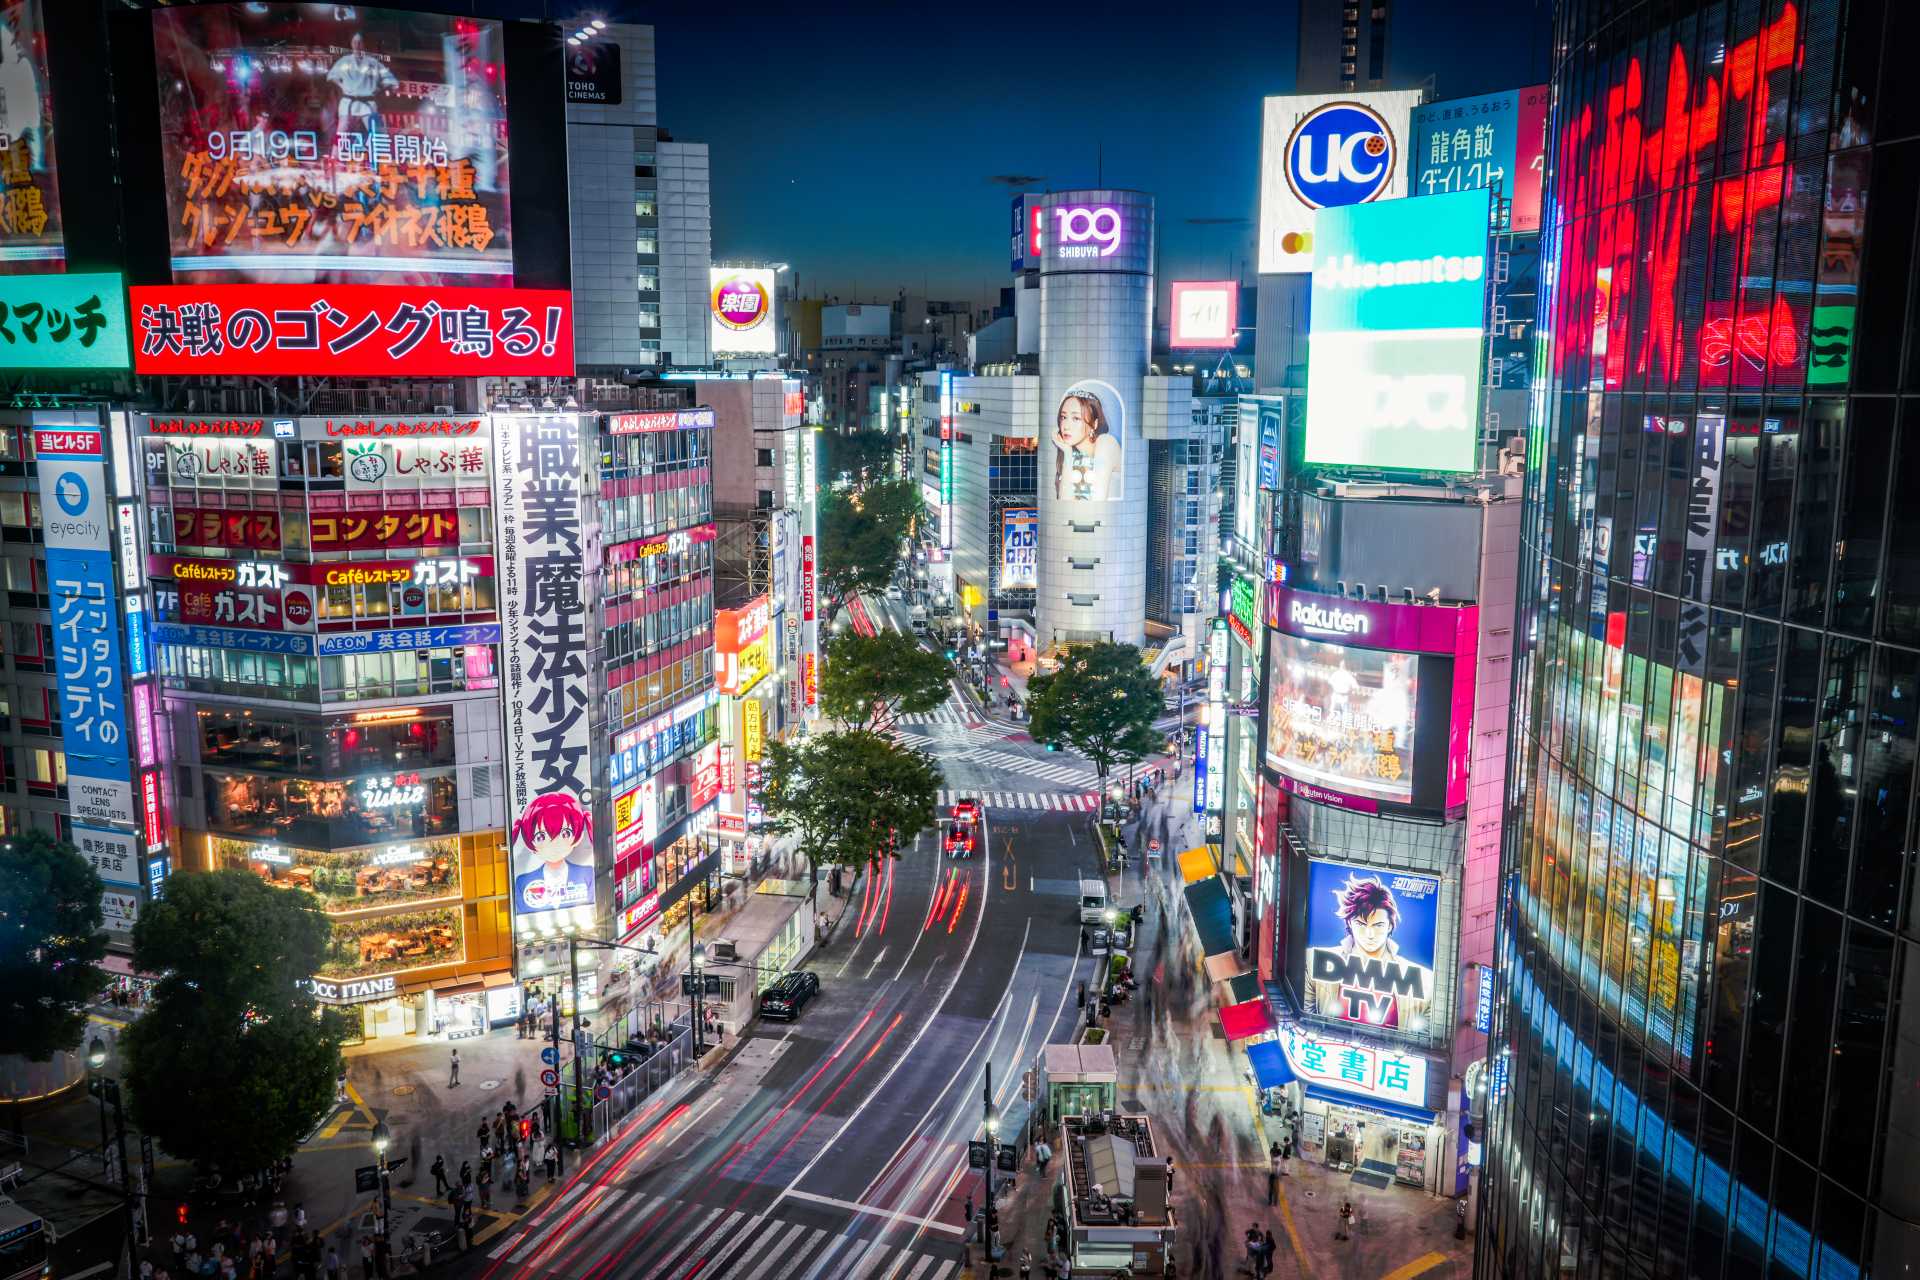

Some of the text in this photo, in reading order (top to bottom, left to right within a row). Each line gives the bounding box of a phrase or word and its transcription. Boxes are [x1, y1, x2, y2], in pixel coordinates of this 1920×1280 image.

[568, 81, 595, 91] TOHO
[568, 91, 606, 100] CINEMAS
[207, 131, 448, 167] 9月19日 配信開始
[1431, 123, 1494, 164] 龍角散
[1421, 162, 1504, 194] ダイレクト
[1056, 207, 1121, 256] 109
[1059, 246, 1099, 258] SHIBUYA
[721, 293, 761, 313] 楽園
[141, 298, 563, 359] 決戦のゴング鳴る!
[326, 420, 481, 437] しゃぶしゃぶバイキング
[41, 434, 94, 451] 当ビル5F
[146, 452, 167, 470] 9F
[205, 447, 272, 476] しゃぶ葉
[395, 446, 484, 475] しゃぶ葉
[51, 519, 100, 541] eyecity
[175, 513, 278, 541] プライス
[311, 513, 457, 543] コンタクト
[238, 562, 289, 589] ガスト
[414, 559, 480, 584] ガスト
[155, 591, 179, 610] 7F
[215, 590, 277, 625] ガスト
[1291, 601, 1368, 634] Rakuten
[195, 630, 286, 649] 英会話イーオン
[324, 636, 368, 652] AEON
[378, 625, 498, 650] 英会話イーオン
[55, 580, 95, 742] アイシティ
[87, 582, 119, 744] コンタクトの
[81, 785, 118, 798] CONTACT
[91, 797, 111, 808] LENS
[77, 805, 127, 820] SPECIALISTS
[1312, 947, 1426, 1001] DMM
[1342, 988, 1393, 1026] TV
